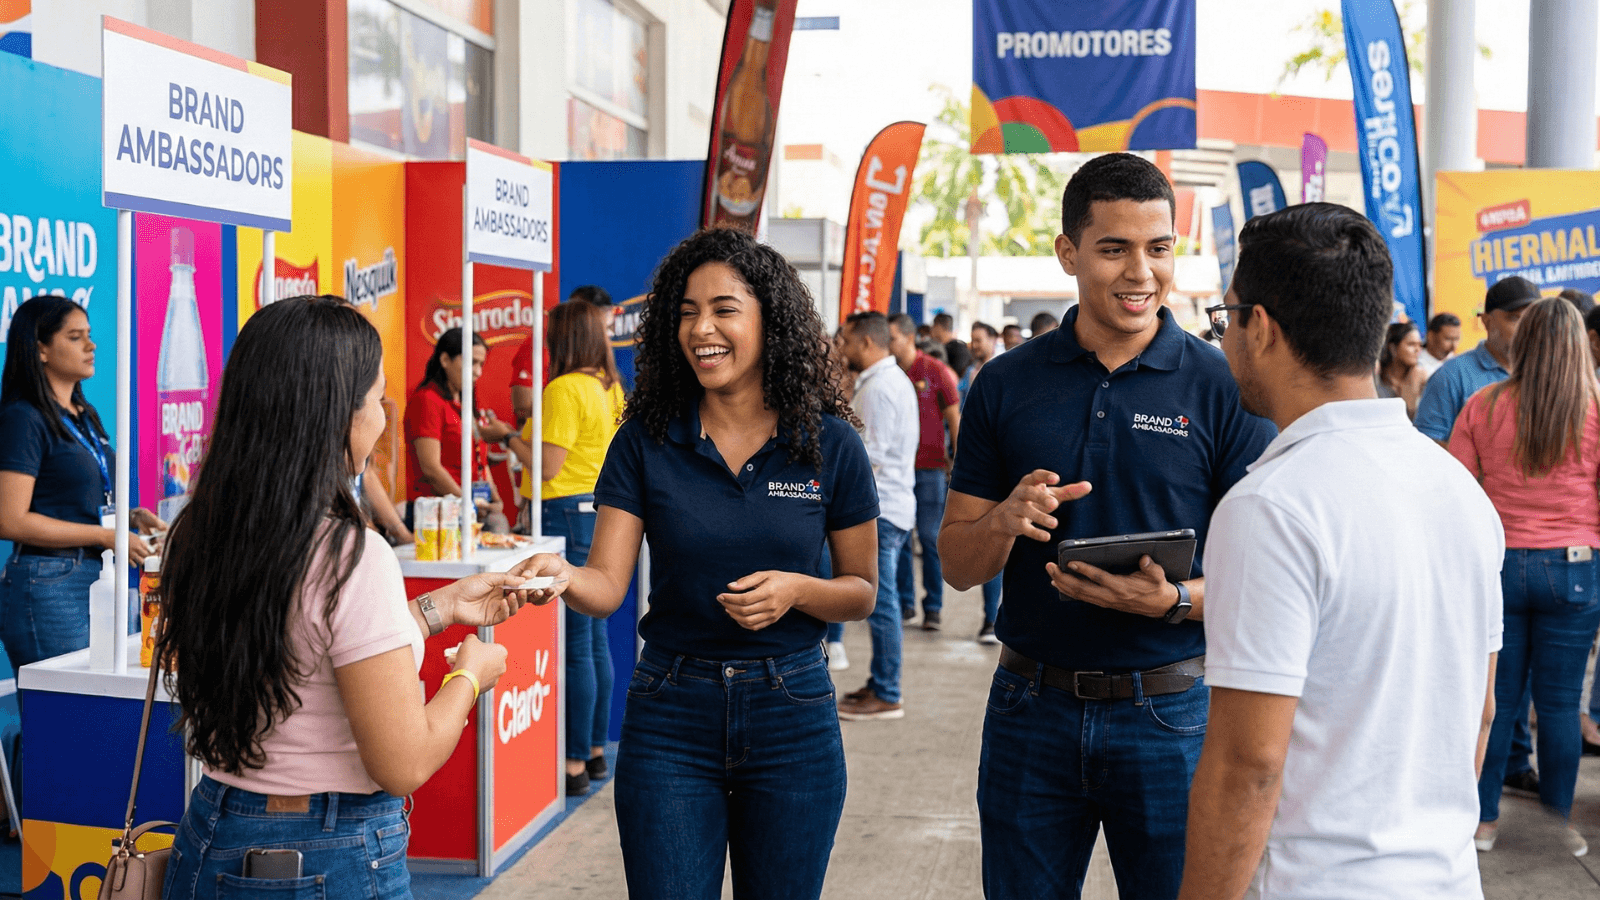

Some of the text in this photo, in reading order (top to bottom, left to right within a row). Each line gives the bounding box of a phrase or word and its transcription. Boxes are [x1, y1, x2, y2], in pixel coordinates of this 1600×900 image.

[996, 28, 1172, 58] PROMOTORES
[168, 82, 244, 134] BRAND
[116, 123, 283, 190] AMBASSADORS
[495, 178, 530, 208] BRAND
[473, 206, 548, 243] AMBASSADORS
[0, 212, 97, 283] BRAND
[162, 401, 204, 440] BRAND
[1131, 422, 1189, 437] AMBASSADORS
[1134, 413, 1173, 427] BRAND
[767, 490, 822, 500] AMBASSADORS
[768, 481, 806, 492] BRAND
[497, 680, 544, 744] Claro
